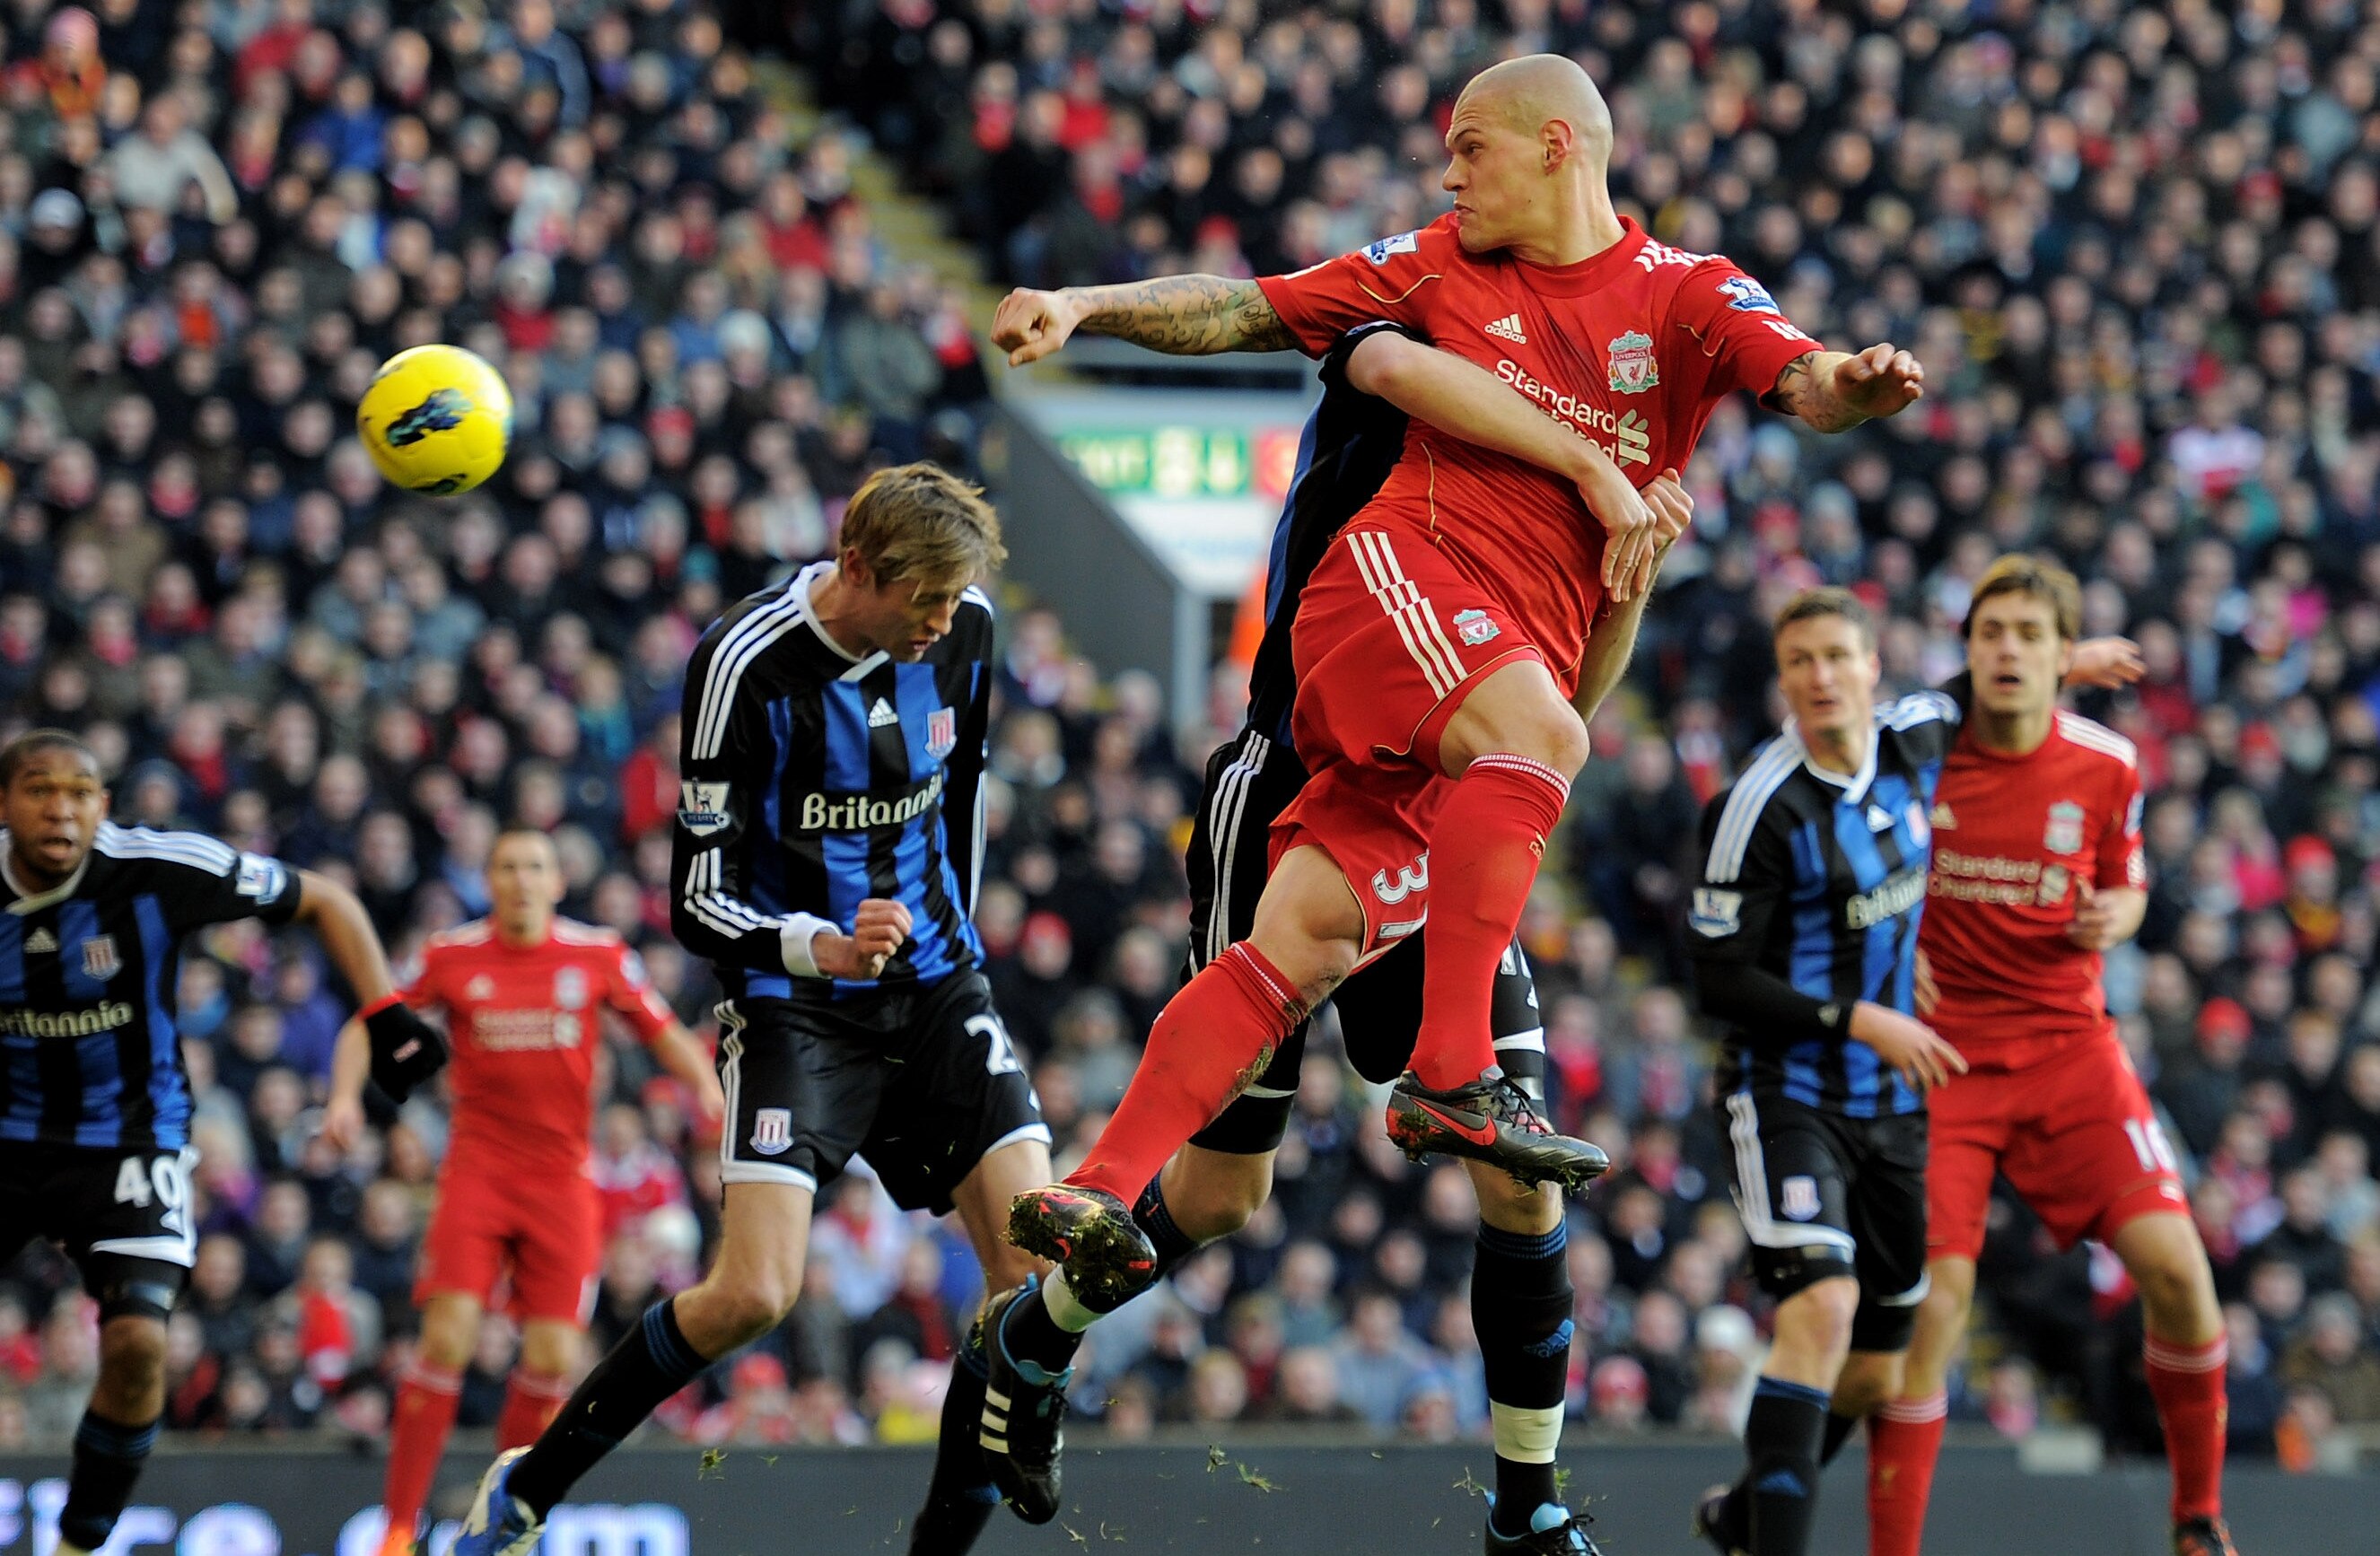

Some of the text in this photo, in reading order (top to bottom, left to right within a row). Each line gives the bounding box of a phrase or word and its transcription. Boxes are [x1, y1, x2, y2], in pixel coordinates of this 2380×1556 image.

[1484, 324, 1527, 345] adidas
[1615, 351, 1648, 361] LIVERPOOL
[1493, 359, 1617, 435] Standard
[0, 1000, 134, 1037] ritannia
[114, 1155, 182, 1210] 40
